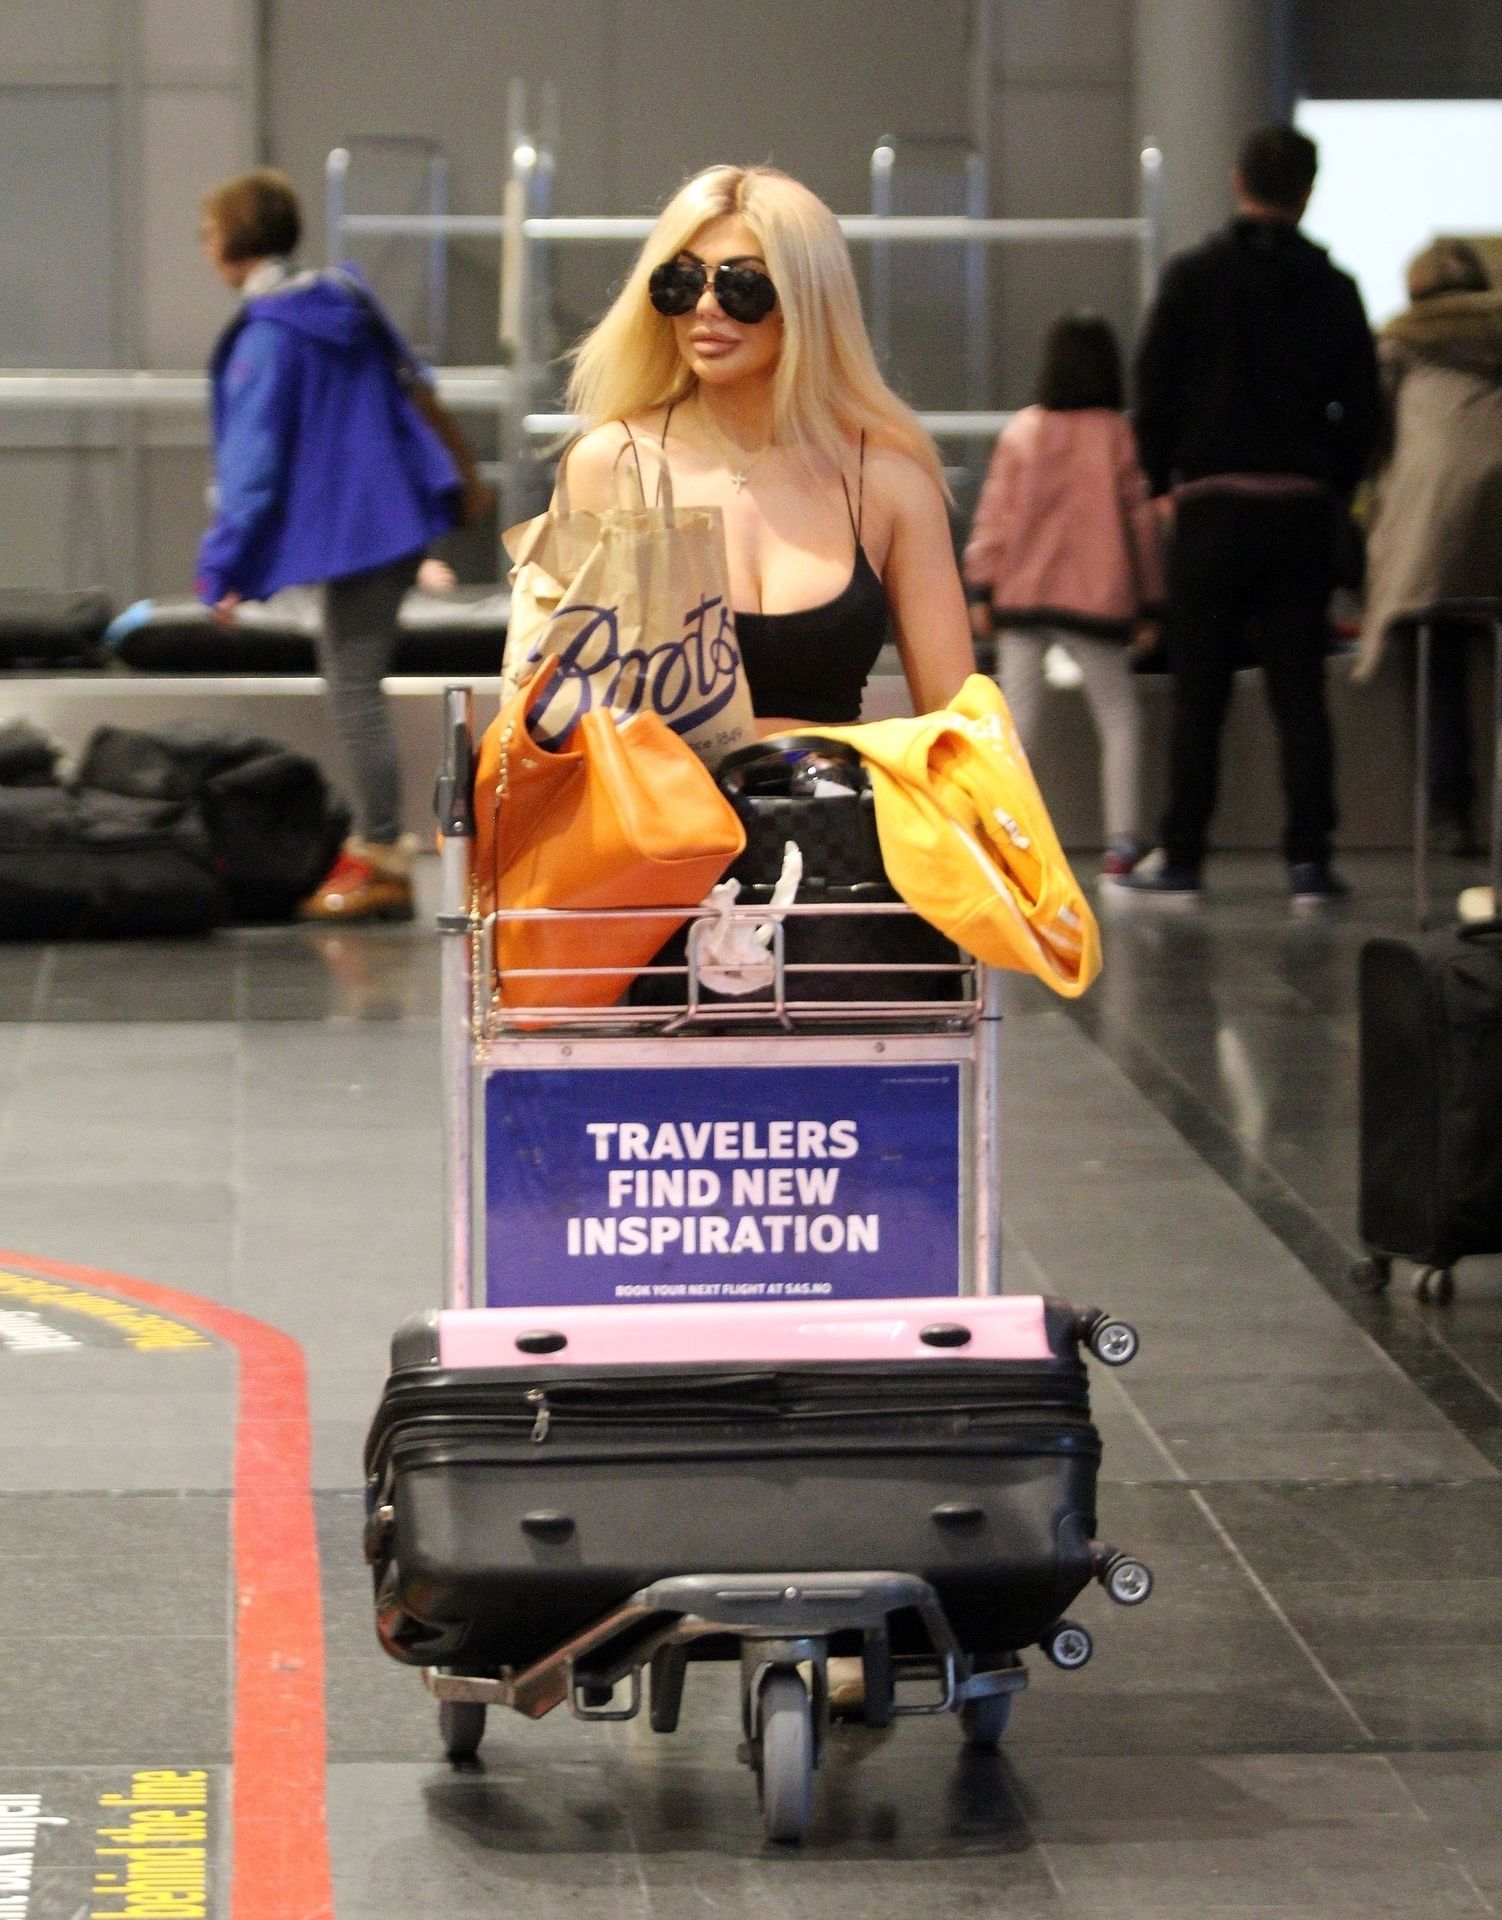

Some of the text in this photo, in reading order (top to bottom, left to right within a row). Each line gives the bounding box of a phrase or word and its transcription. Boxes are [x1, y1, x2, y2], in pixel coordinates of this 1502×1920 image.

[586, 1119, 859, 1161] TRAVELERS
[608, 1167, 840, 1208] FIND NEW
[567, 1214, 879, 1256] INSPIRATION
[615, 1282, 832, 1297] BOOK YOUR NEXT FLIGHT AT SAS.NO
[90, 1770, 208, 1919] behind the line
